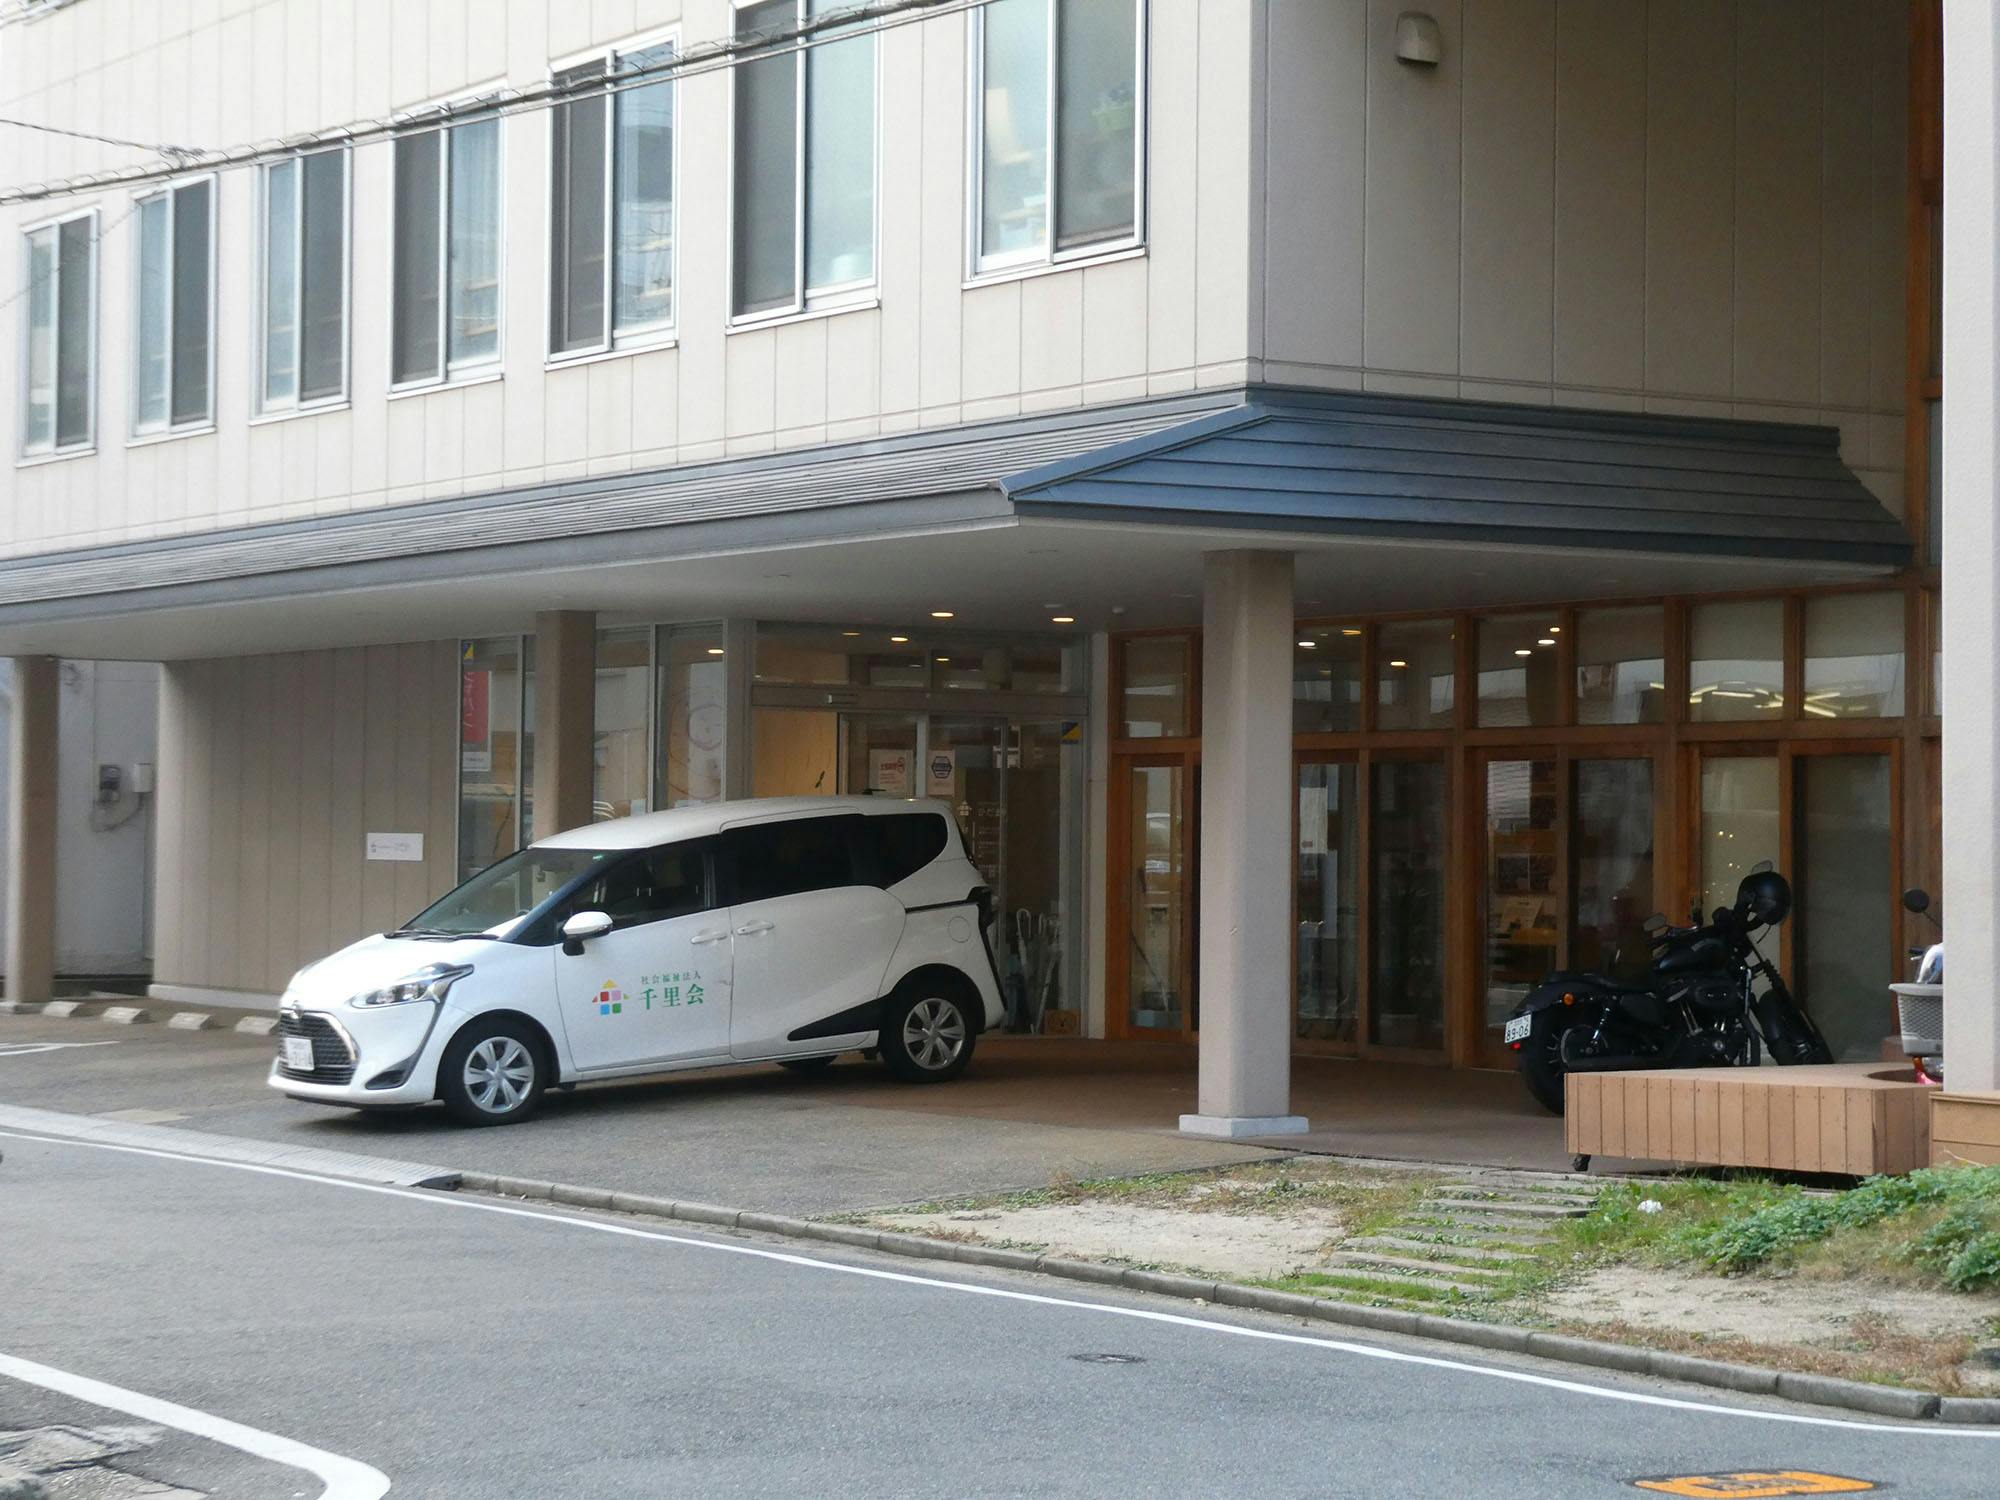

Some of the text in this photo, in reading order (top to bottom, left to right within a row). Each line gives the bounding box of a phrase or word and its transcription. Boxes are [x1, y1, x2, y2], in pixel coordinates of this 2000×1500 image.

[640, 983, 704, 1010] 千里会
[1506, 1023, 1529, 1041] 89-06
